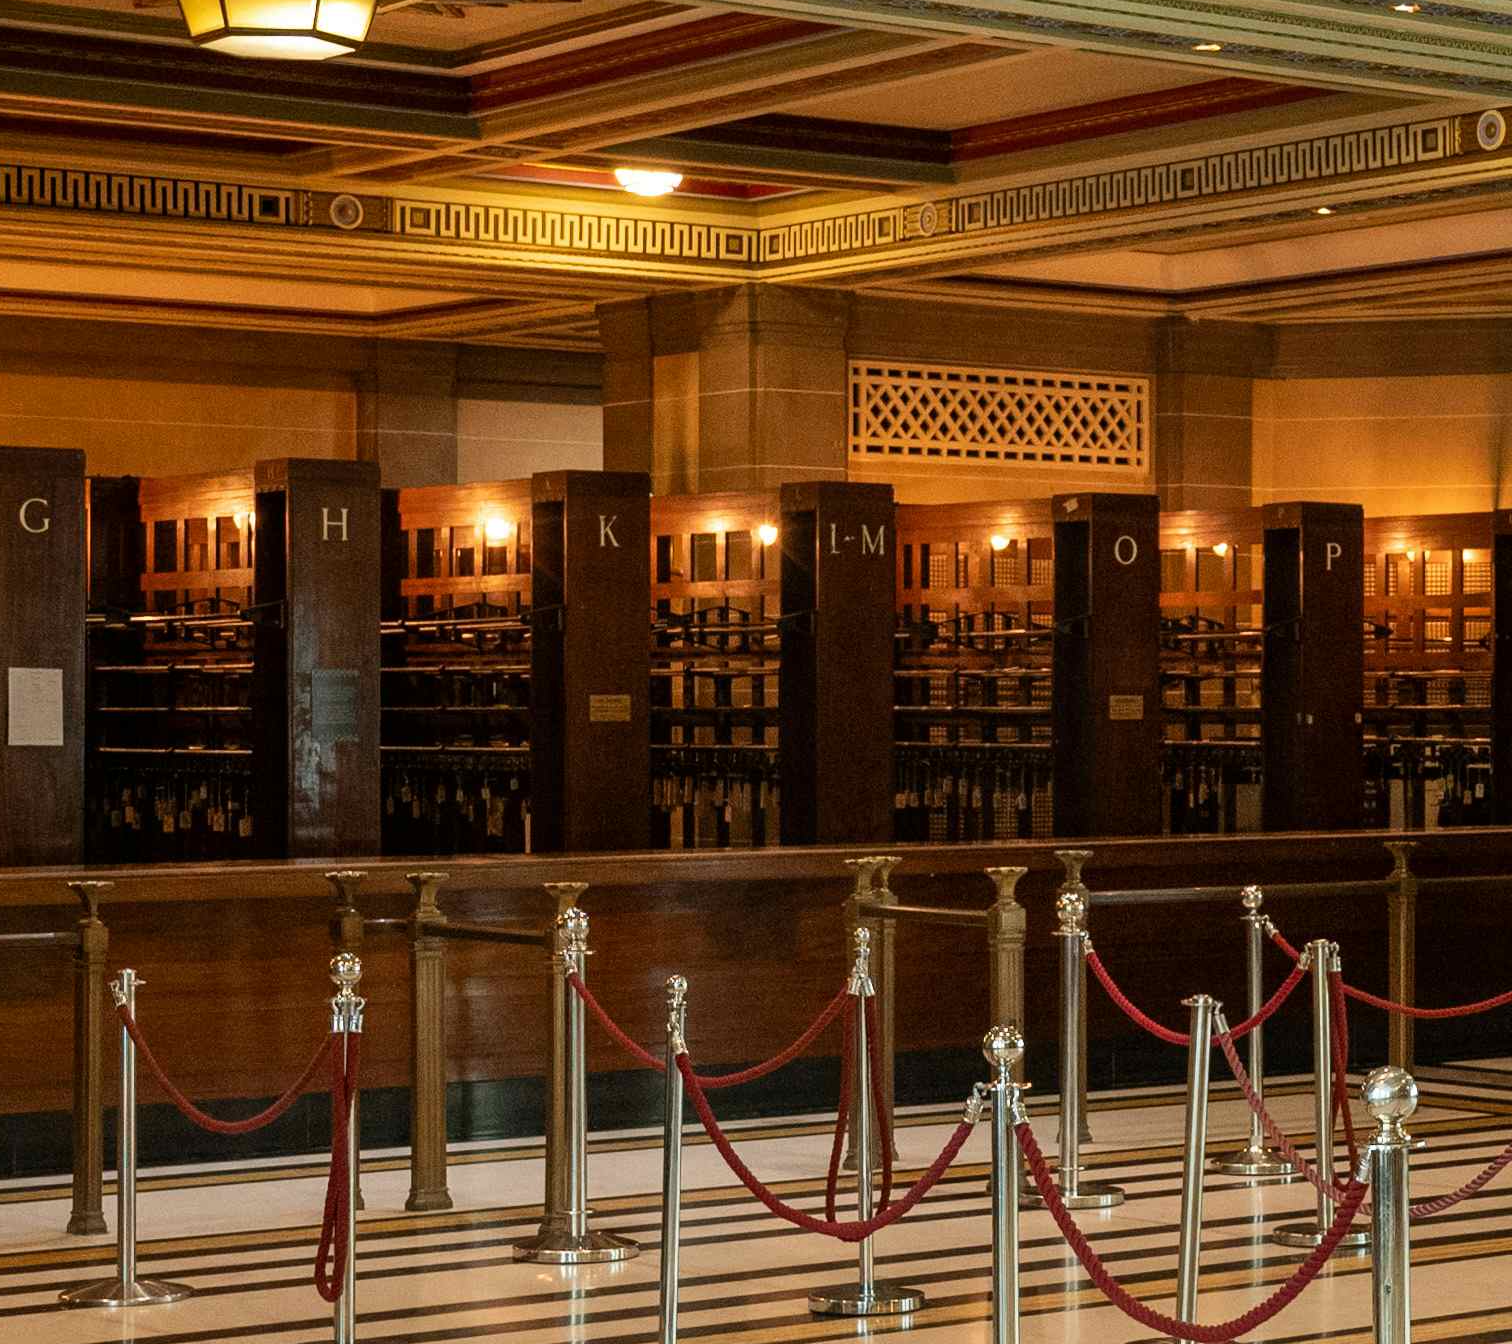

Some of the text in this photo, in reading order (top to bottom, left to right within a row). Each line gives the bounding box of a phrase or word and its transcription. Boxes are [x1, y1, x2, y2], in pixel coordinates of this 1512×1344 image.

[19, 498, 50, 533] G
[321, 507, 349, 541] H
[599, 514, 621, 548] K
[1114, 535, 1137, 565] O
[1326, 542, 1342, 571] P
